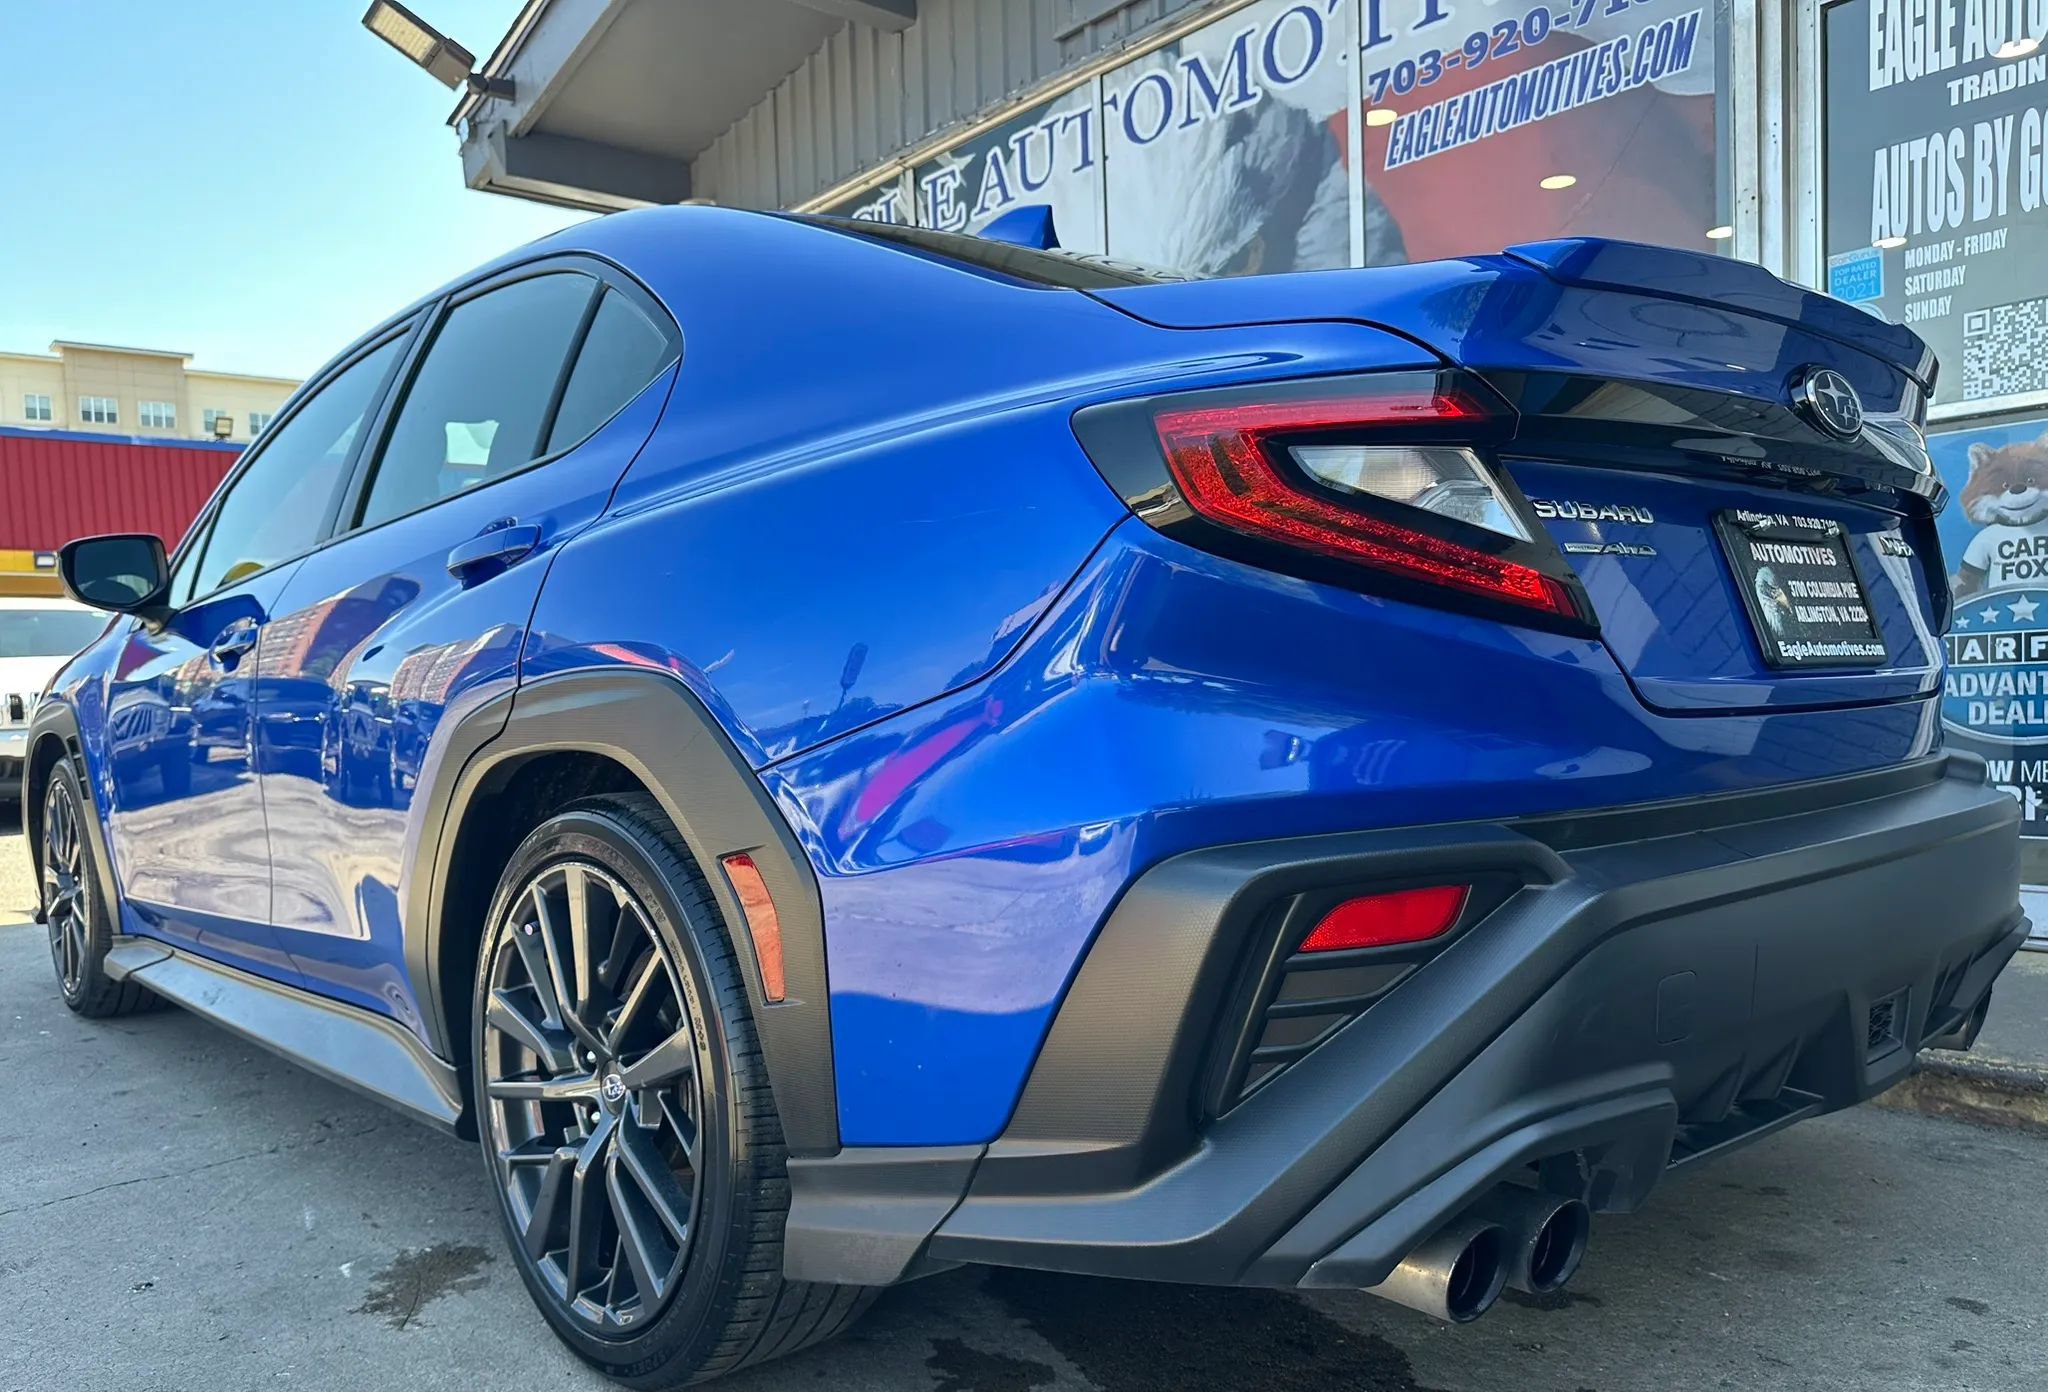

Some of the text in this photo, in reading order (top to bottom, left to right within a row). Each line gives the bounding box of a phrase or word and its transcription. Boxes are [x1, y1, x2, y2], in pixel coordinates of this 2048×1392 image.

[1869, 0, 1957, 92] EAGLE
[1385, 10, 1702, 171] EAGLEAUTOMOTIVES.COM
[1947, 54, 2047, 106] TRADIN
[1872, 127, 1965, 243] AUTOS
[1972, 114, 2014, 222] BY
[1904, 240, 1955, 270] MONDAY
[1963, 229, 2008, 257] FRIDAY
[1834, 269, 1877, 287] DEALER
[1904, 265, 1967, 296] SATURDAY
[1904, 295, 1953, 324] SUNDAY
[1532, 499, 1655, 525] SUBARU
[1775, 513, 1790, 527] VA
[1750, 542, 1837, 567] AUTOMOTIVES
[1997, 536, 2048, 560] CAR
[2001, 557, 2048, 581] FOX
[1806, 581, 1844, 598] COLUMBIA
[1840, 582, 1859, 598] PIKE
[1795, 605, 1841, 626] ARLINGTON,
[1836, 606, 1852, 622] VA
[1777, 640, 1885, 661] EagleAutomotives.com
[1946, 635, 2048, 661] ARF
[1986, 760, 2014, 782] W
